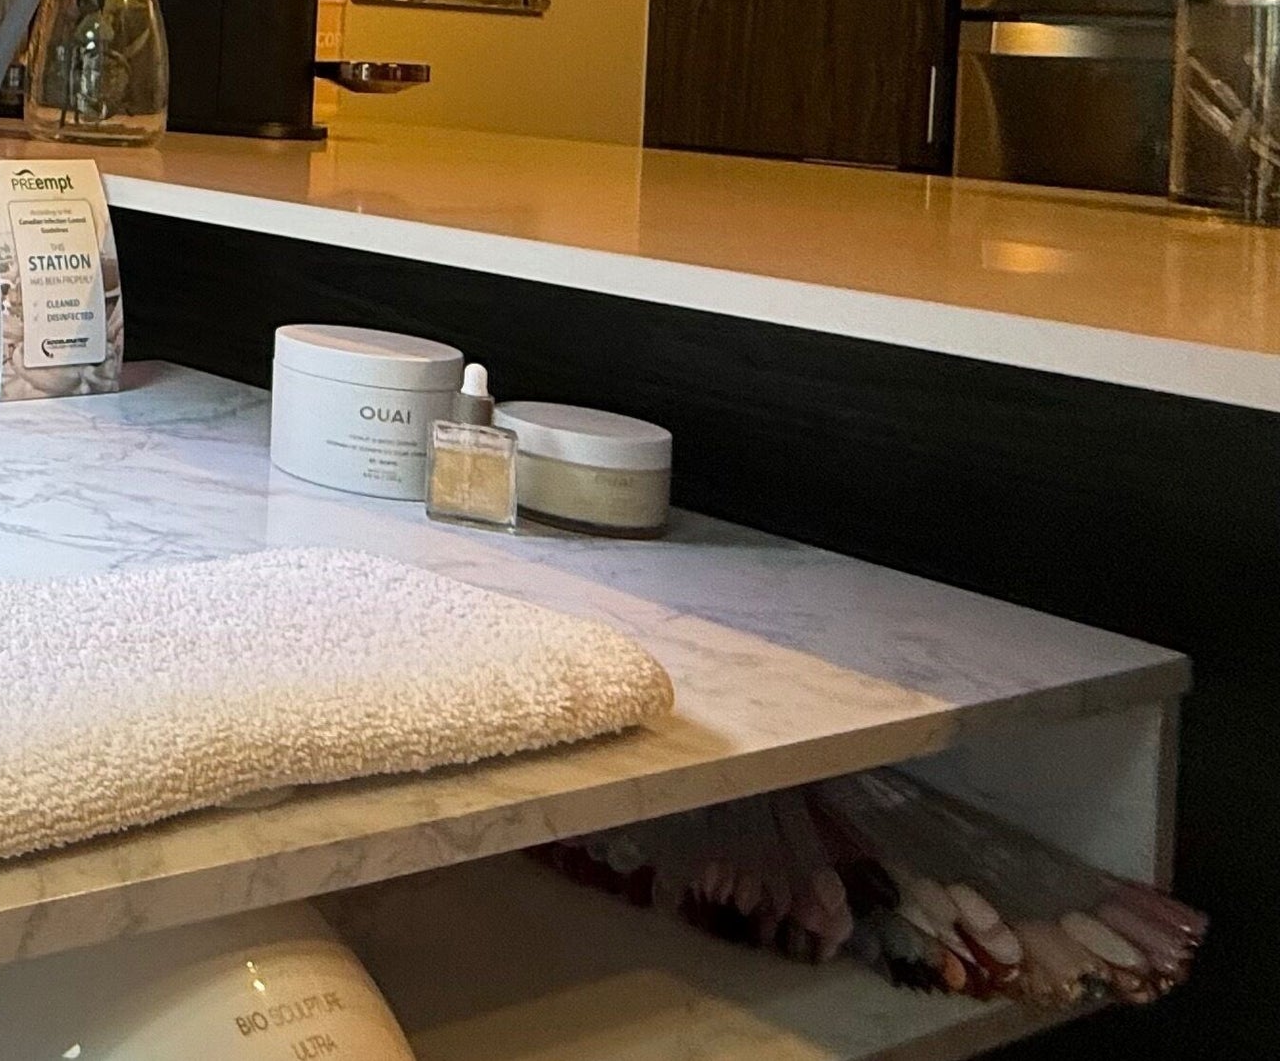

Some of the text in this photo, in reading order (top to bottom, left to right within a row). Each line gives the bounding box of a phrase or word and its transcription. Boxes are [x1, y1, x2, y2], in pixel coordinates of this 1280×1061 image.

[11, 174, 74, 193] PREempt
[28, 253, 91, 271] STATION
[46, 298, 80, 308] CLEANED
[47, 311, 94, 322] DISINFECTED
[360, 405, 411, 425] OUAI
[236, 991, 343, 1037] BIO SCULPTURE
[291, 1033, 338, 1061] ULTRA
